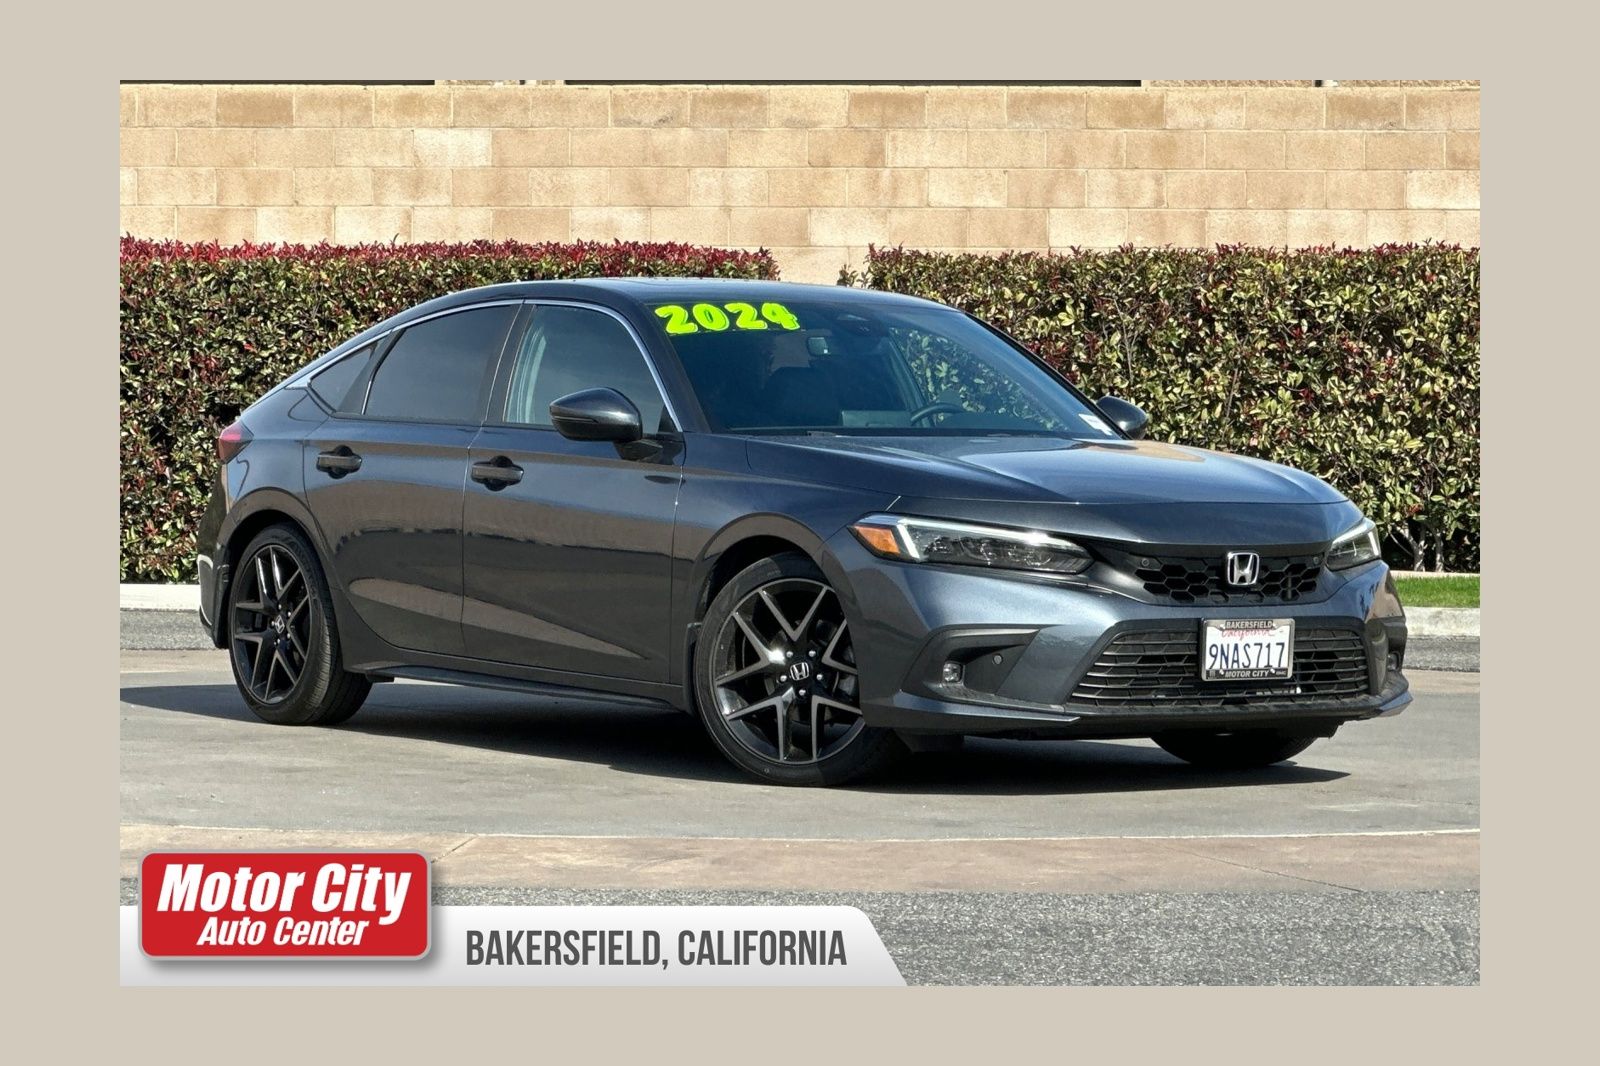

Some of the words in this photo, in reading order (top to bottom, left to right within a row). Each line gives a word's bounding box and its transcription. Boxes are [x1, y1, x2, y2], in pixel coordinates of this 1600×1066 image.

[655, 302, 800, 334] 2024
[1226, 621, 1272, 629] BAKERSFIELD
[1209, 642, 1285, 669] 9NAS717
[1224, 670, 1250, 678] MOTOR
